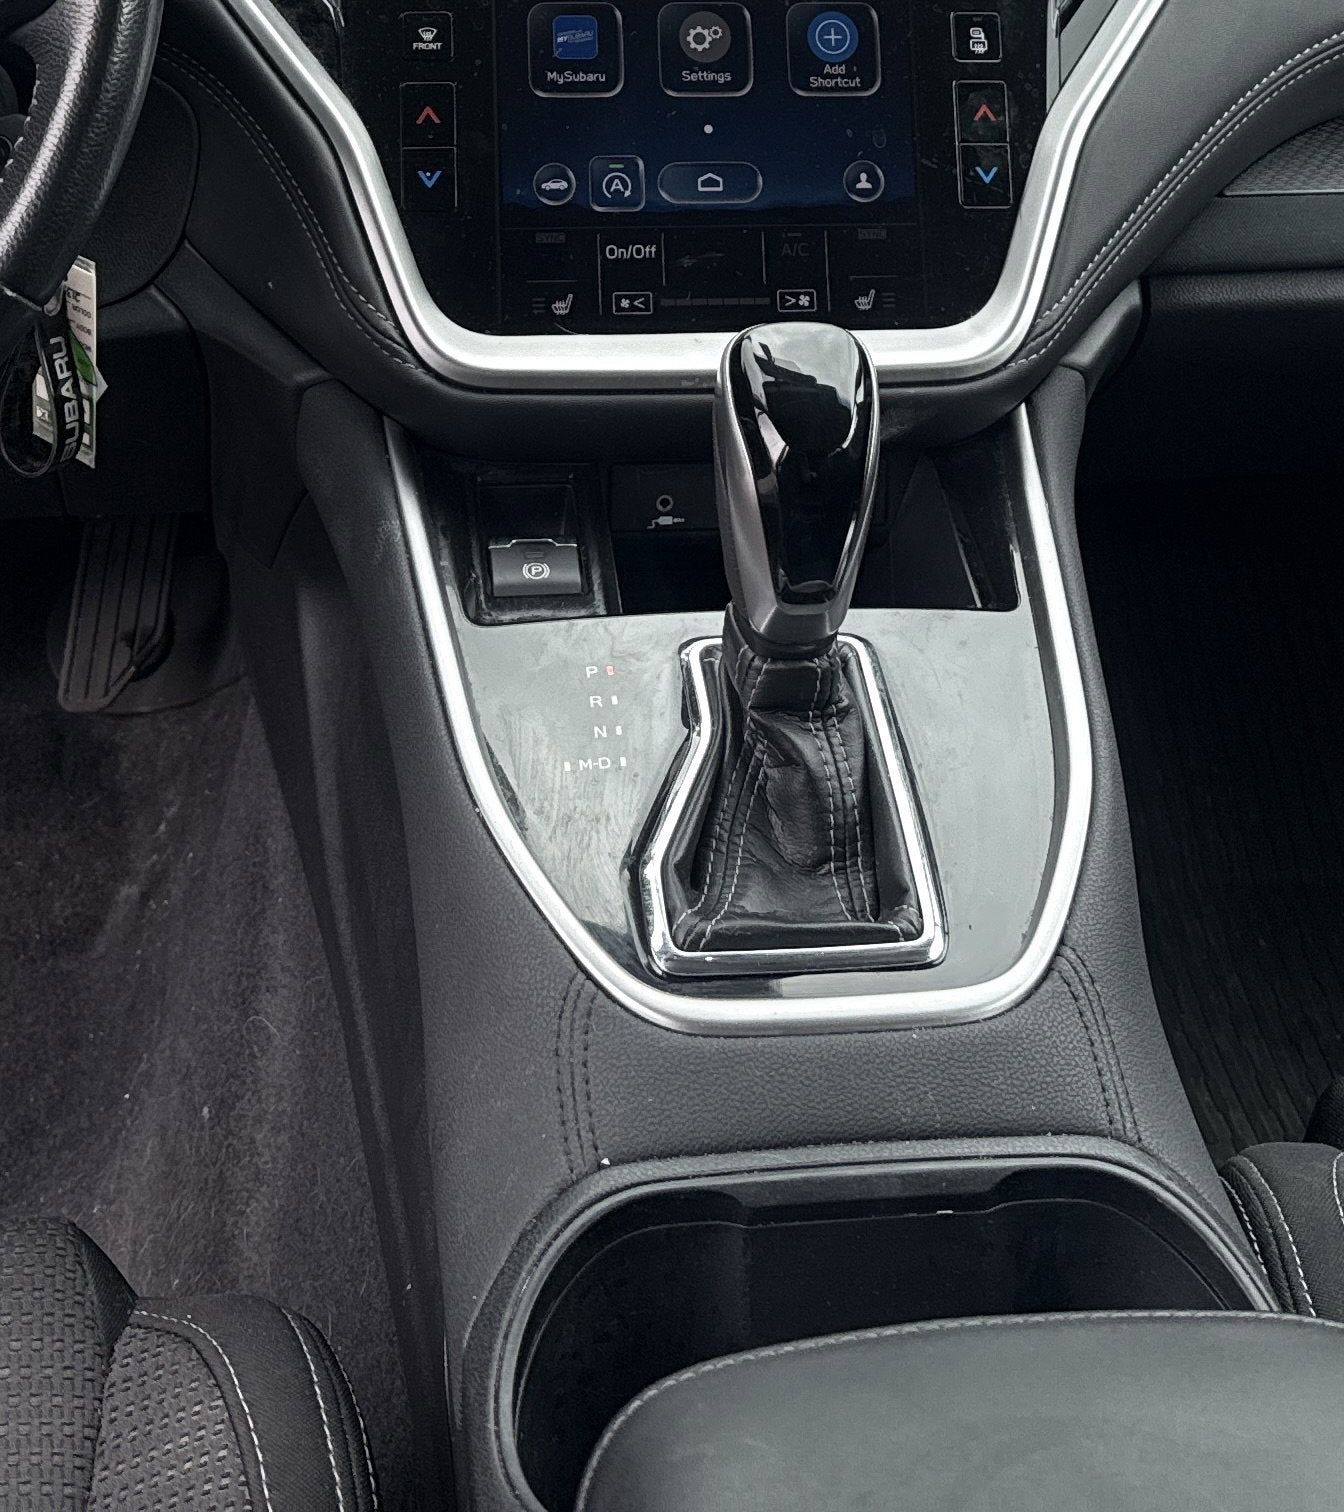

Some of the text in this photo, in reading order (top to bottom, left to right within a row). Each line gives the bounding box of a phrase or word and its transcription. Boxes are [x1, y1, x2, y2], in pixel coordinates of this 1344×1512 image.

[412, 42, 443, 50] FRONT
[823, 64, 846, 75] Add
[547, 71, 606, 85] MySubaru
[681, 70, 732, 84] Settings
[809, 76, 861, 88] Shortcut
[606, 244, 656, 260] On/Off
[781, 242, 810, 258] A/C
[49, 335, 80, 463] SUBARU
[585, 666, 598, 679] P
[589, 695, 603, 708] R
[594, 725, 607, 738] N
